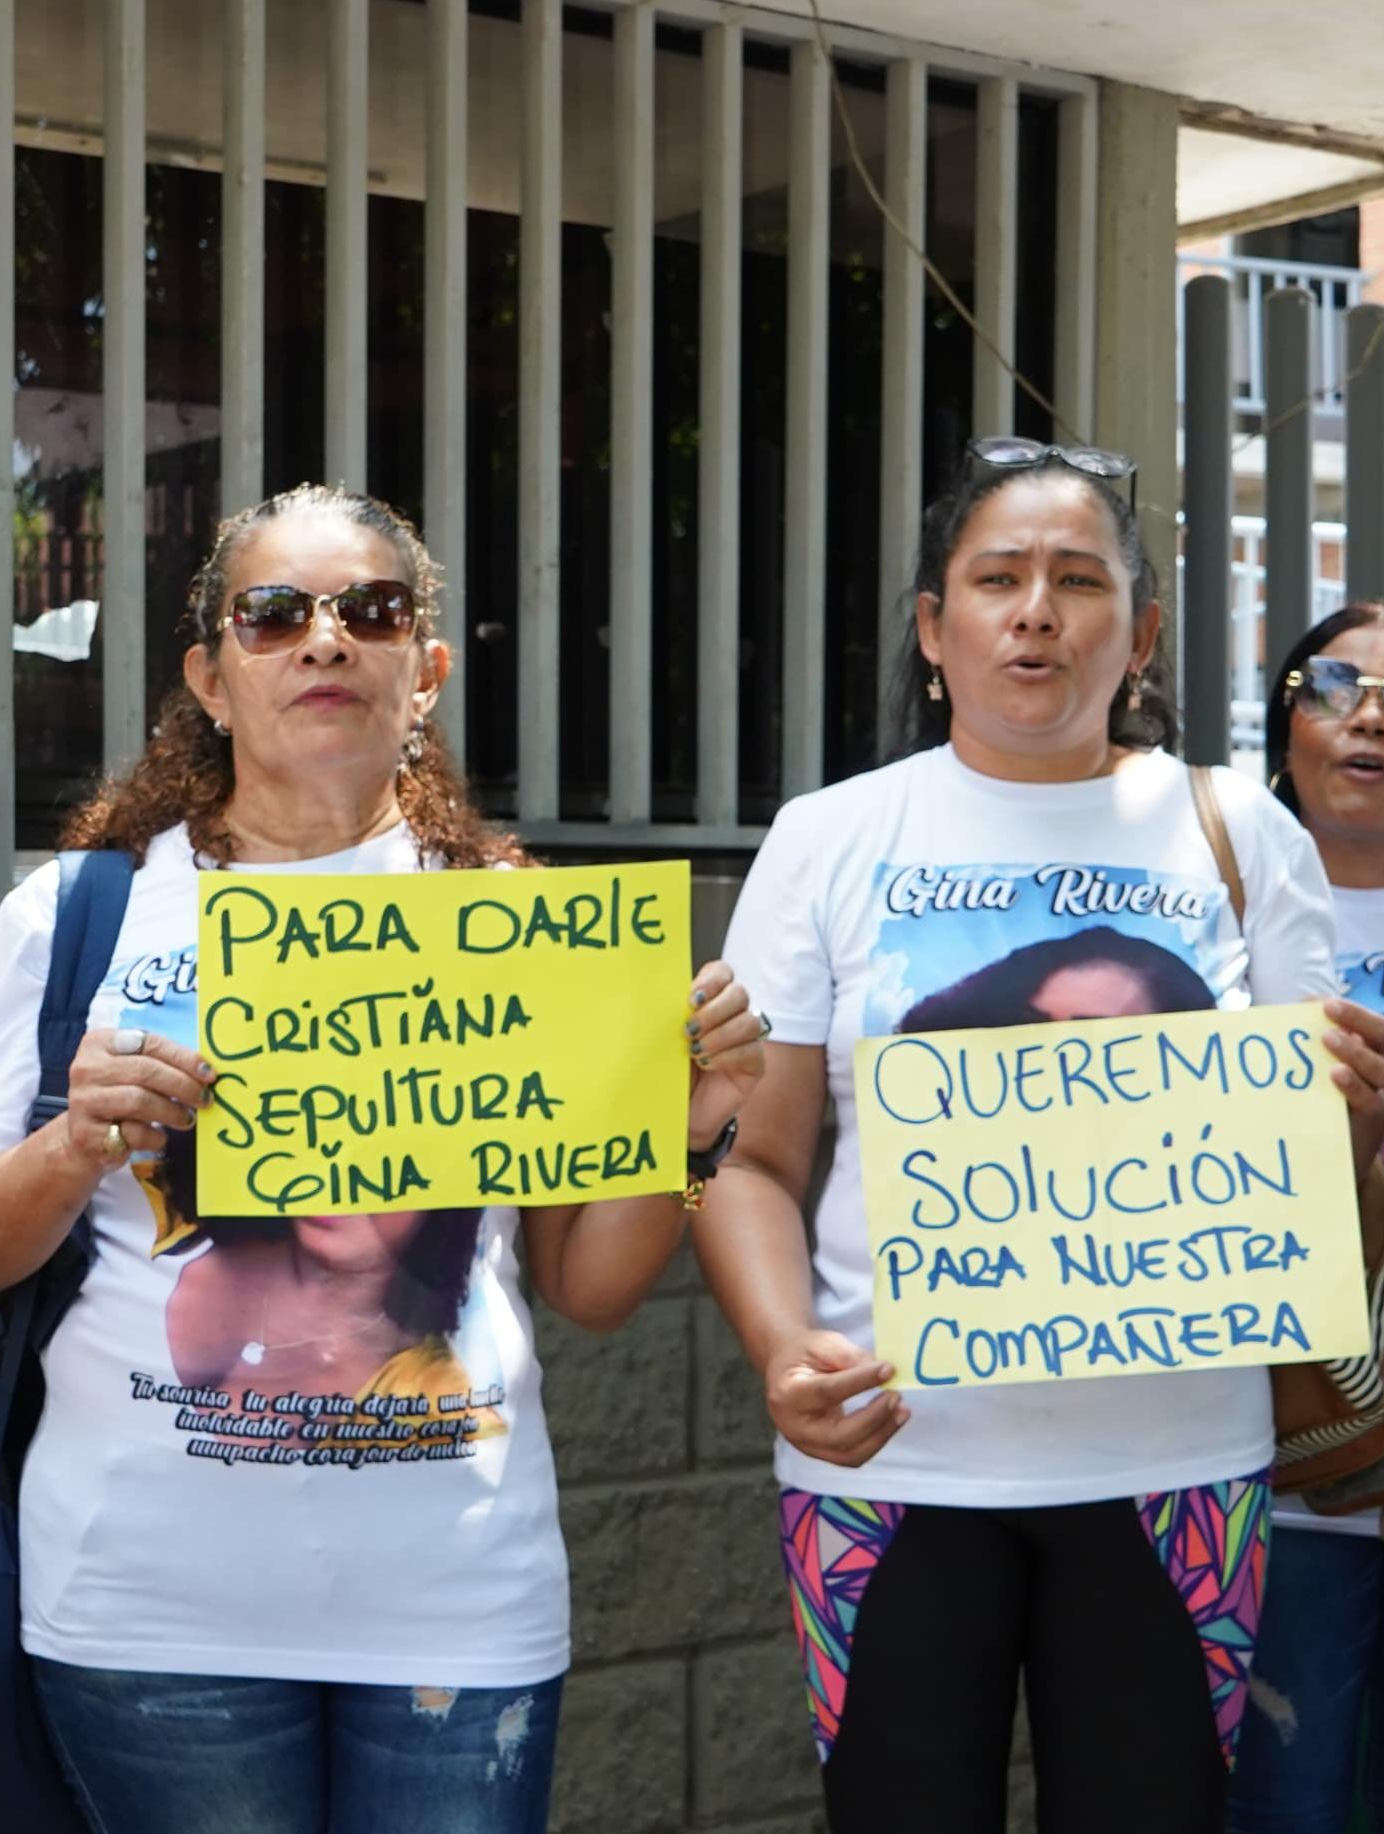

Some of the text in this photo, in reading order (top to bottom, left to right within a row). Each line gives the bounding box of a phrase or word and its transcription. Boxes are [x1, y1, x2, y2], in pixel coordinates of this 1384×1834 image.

[887, 864, 1208, 918] Gina Rivera
[205, 886, 421, 976] PARA
[122, 953, 198, 1005] Gi
[875, 1028, 1315, 1123] QUEREMOS
[471, 1130, 657, 1195] RIVERA
[879, 1227, 1310, 1299] PARA NUESTRA
